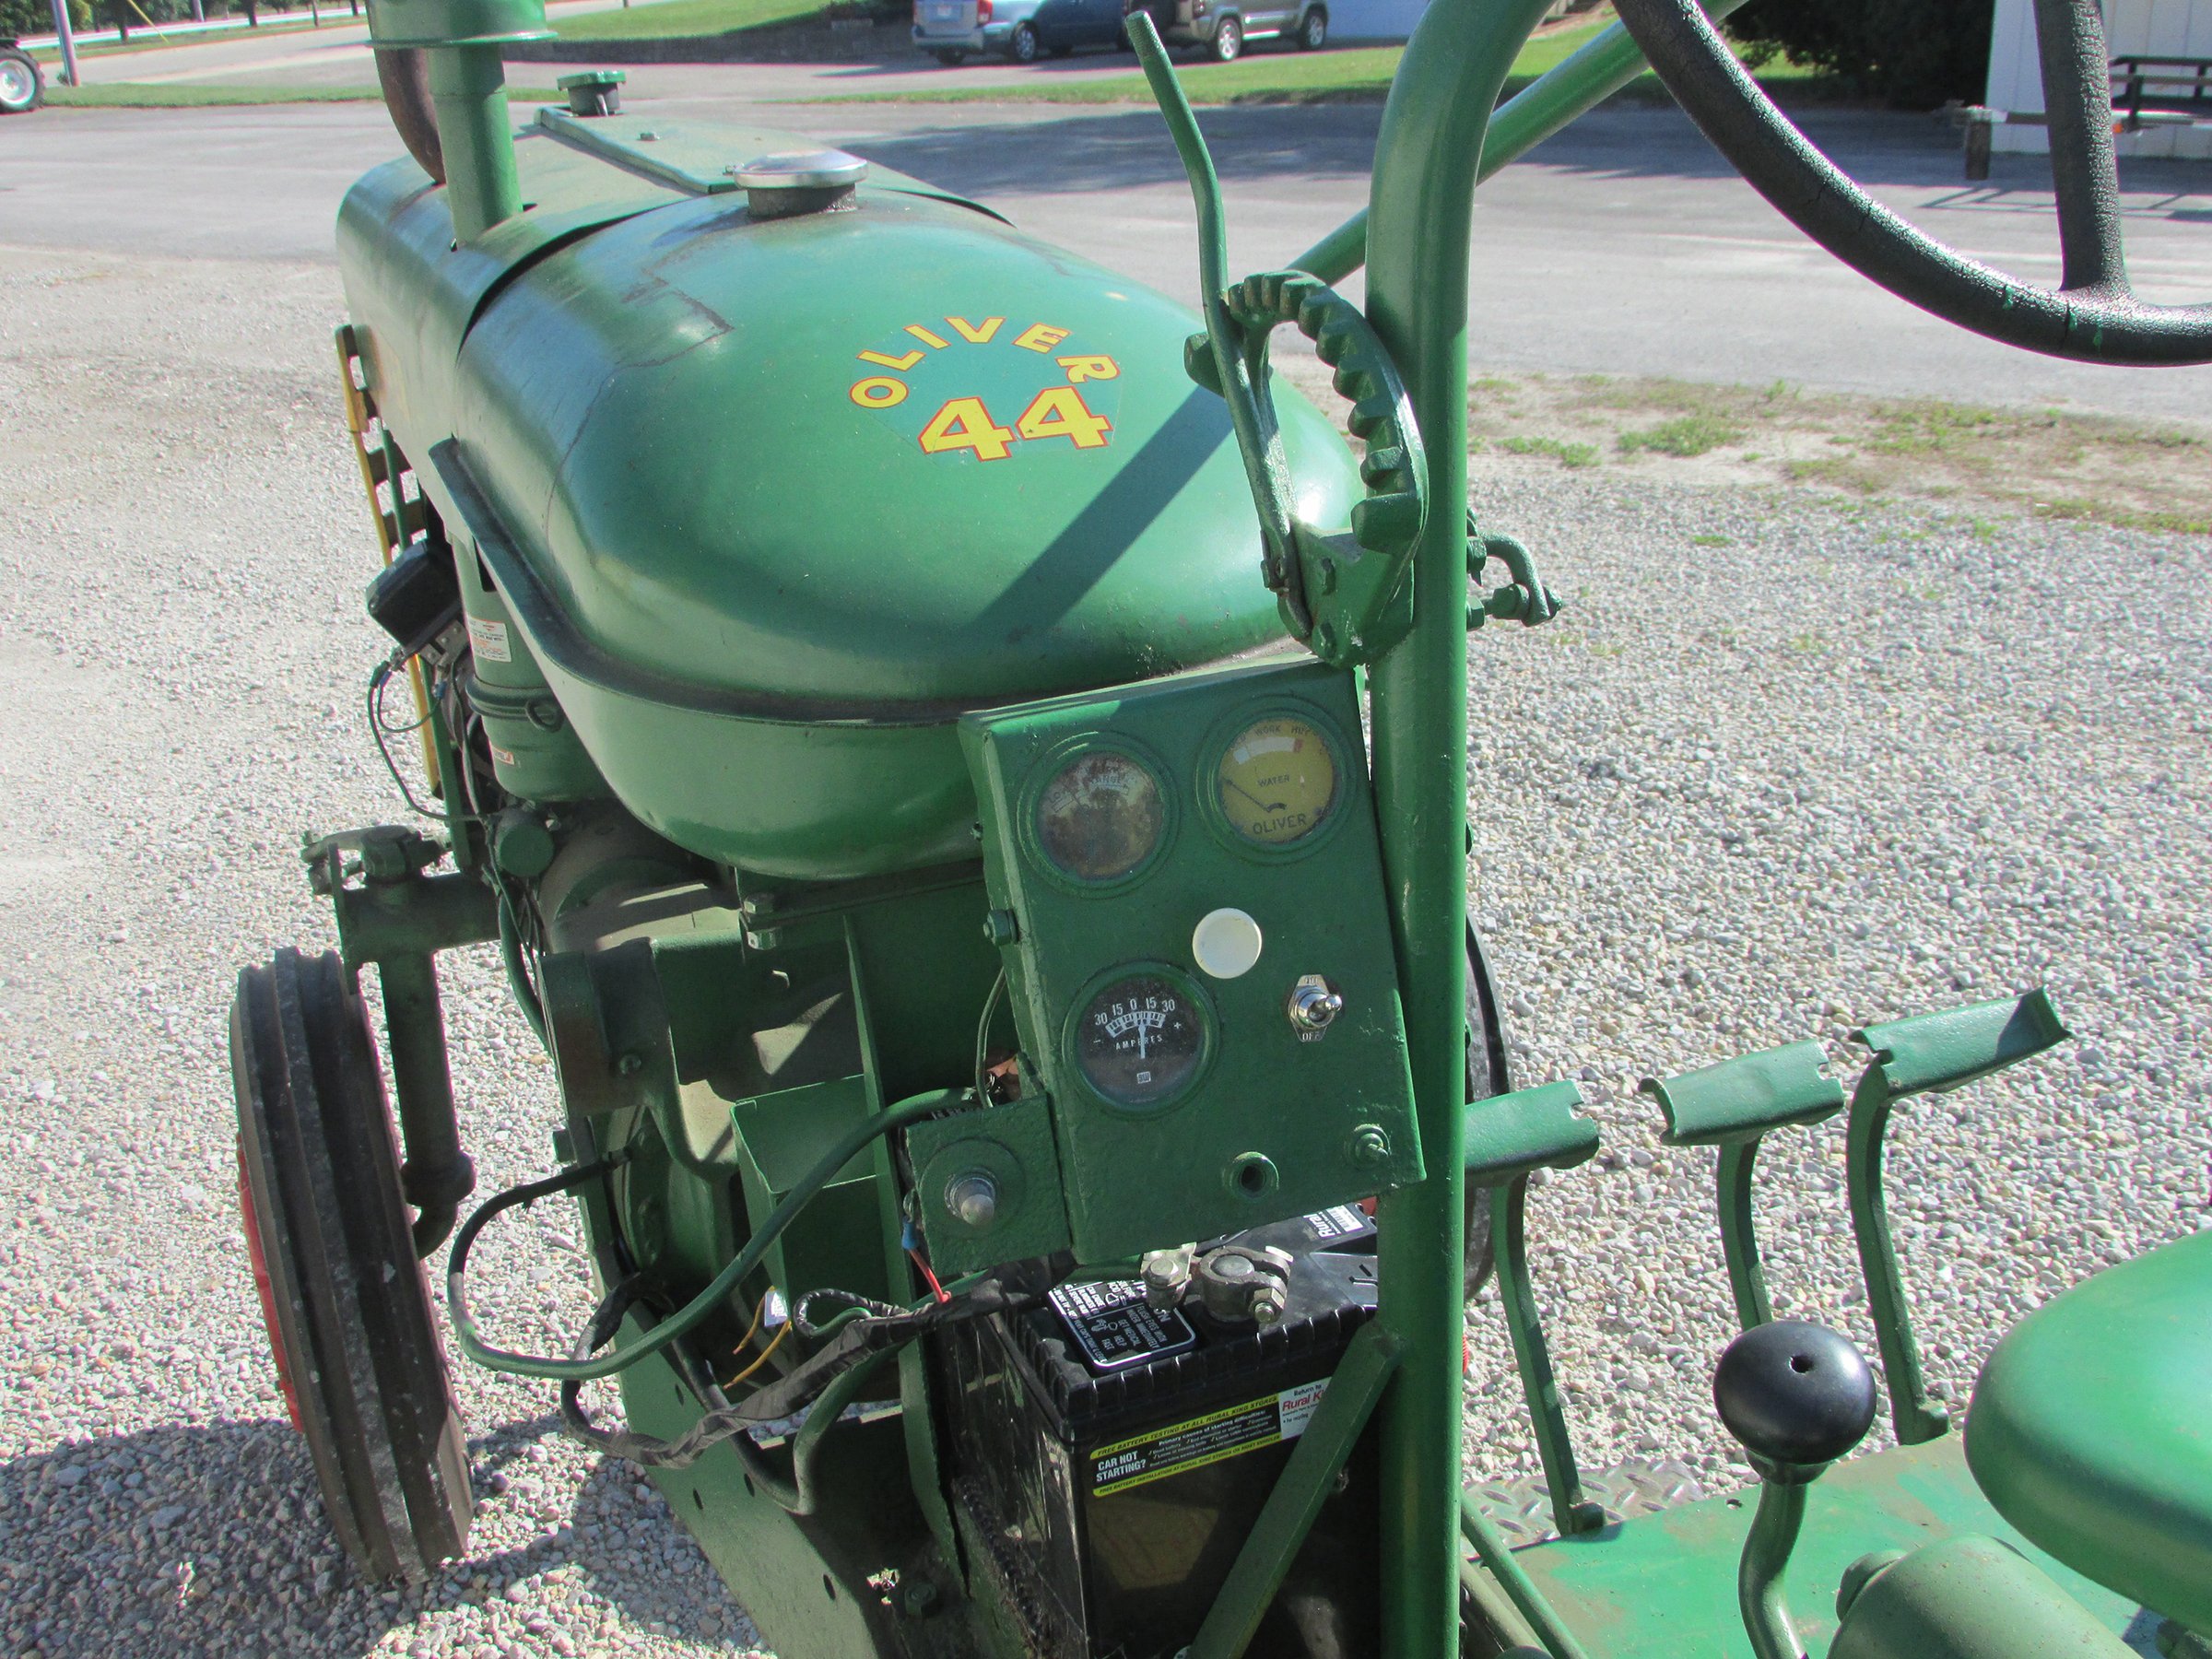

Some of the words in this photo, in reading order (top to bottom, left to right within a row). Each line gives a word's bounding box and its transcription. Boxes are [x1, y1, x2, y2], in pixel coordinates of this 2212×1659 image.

[848, 316, 1121, 408] OLIVER
[917, 385, 1113, 463] 44
[1254, 725, 1282, 736] WORK
[1257, 774, 1289, 788] WATER
[1253, 813, 1307, 834] OLIVER
[1094, 1012, 1108, 1026] 30
[1112, 1003, 1124, 1016] 15
[1130, 998, 1137, 1011] 0
[1146, 996, 1157, 1010] 15
[1161, 998, 1175, 1013] 30
[1115, 1033, 1163, 1051] AMPERES
[1302, 1031, 1320, 1041] OFF
[1302, 1213, 1336, 1238] Rural
[1294, 1386, 1314, 1397] Return
[1282, 1394, 1311, 1411] Rural
[1097, 1447, 1115, 1457] FREE
[1117, 1437, 1148, 1451] BATTERY
[1150, 1426, 1180, 1440] TESTING
[1096, 1458, 1147, 1483] STARTING?
[1098, 1457, 1118, 1472] CAR
[1119, 1451, 1138, 1465] NOT
